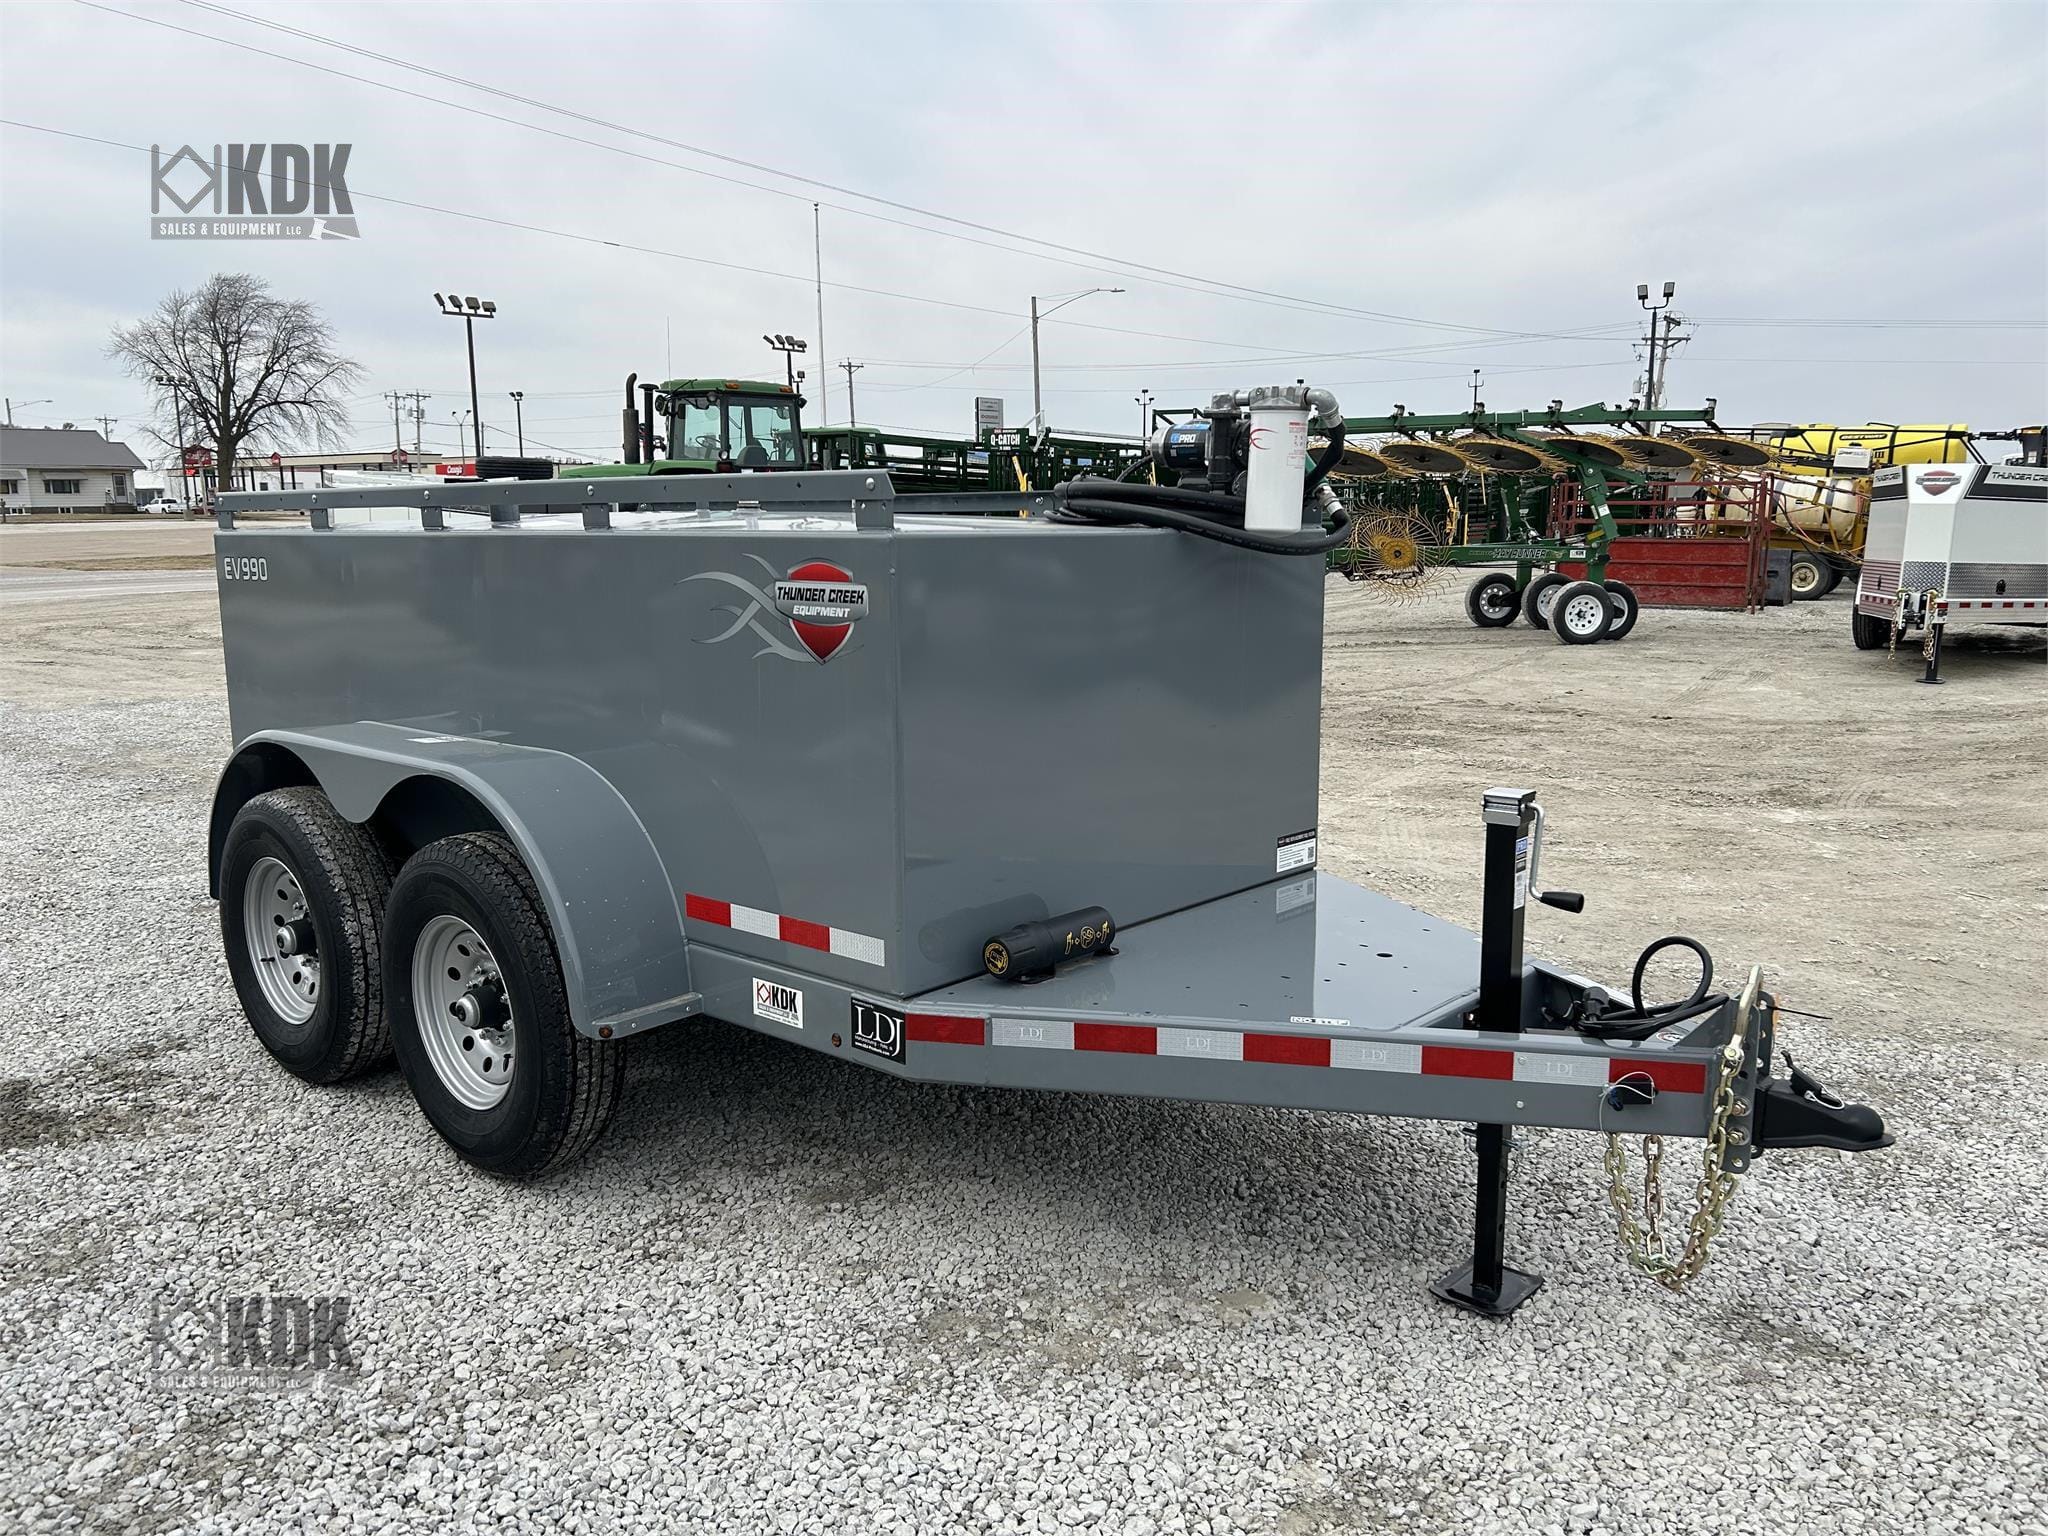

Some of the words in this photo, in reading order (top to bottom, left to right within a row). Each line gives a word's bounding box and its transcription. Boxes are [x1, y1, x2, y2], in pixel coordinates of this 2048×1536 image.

[990, 434, 1021, 446] Q-CATCH
[1992, 471, 2032, 481] THUNDER
[1511, 548, 1547, 559] RUNNER
[224, 557, 268, 581] EV990
[777, 586, 826, 602] THUNDER
[828, 589, 865, 604] CREEK
[793, 605, 850, 618] EQUIPMENT
[771, 985, 798, 1014] KDK
[854, 1005, 904, 1057] LDJ
[1020, 1027, 1043, 1041] LDJ
[1186, 1036, 1211, 1051] LDJ
[1361, 1048, 1386, 1063] LDJ
[1546, 1062, 1573, 1077] LDJ
